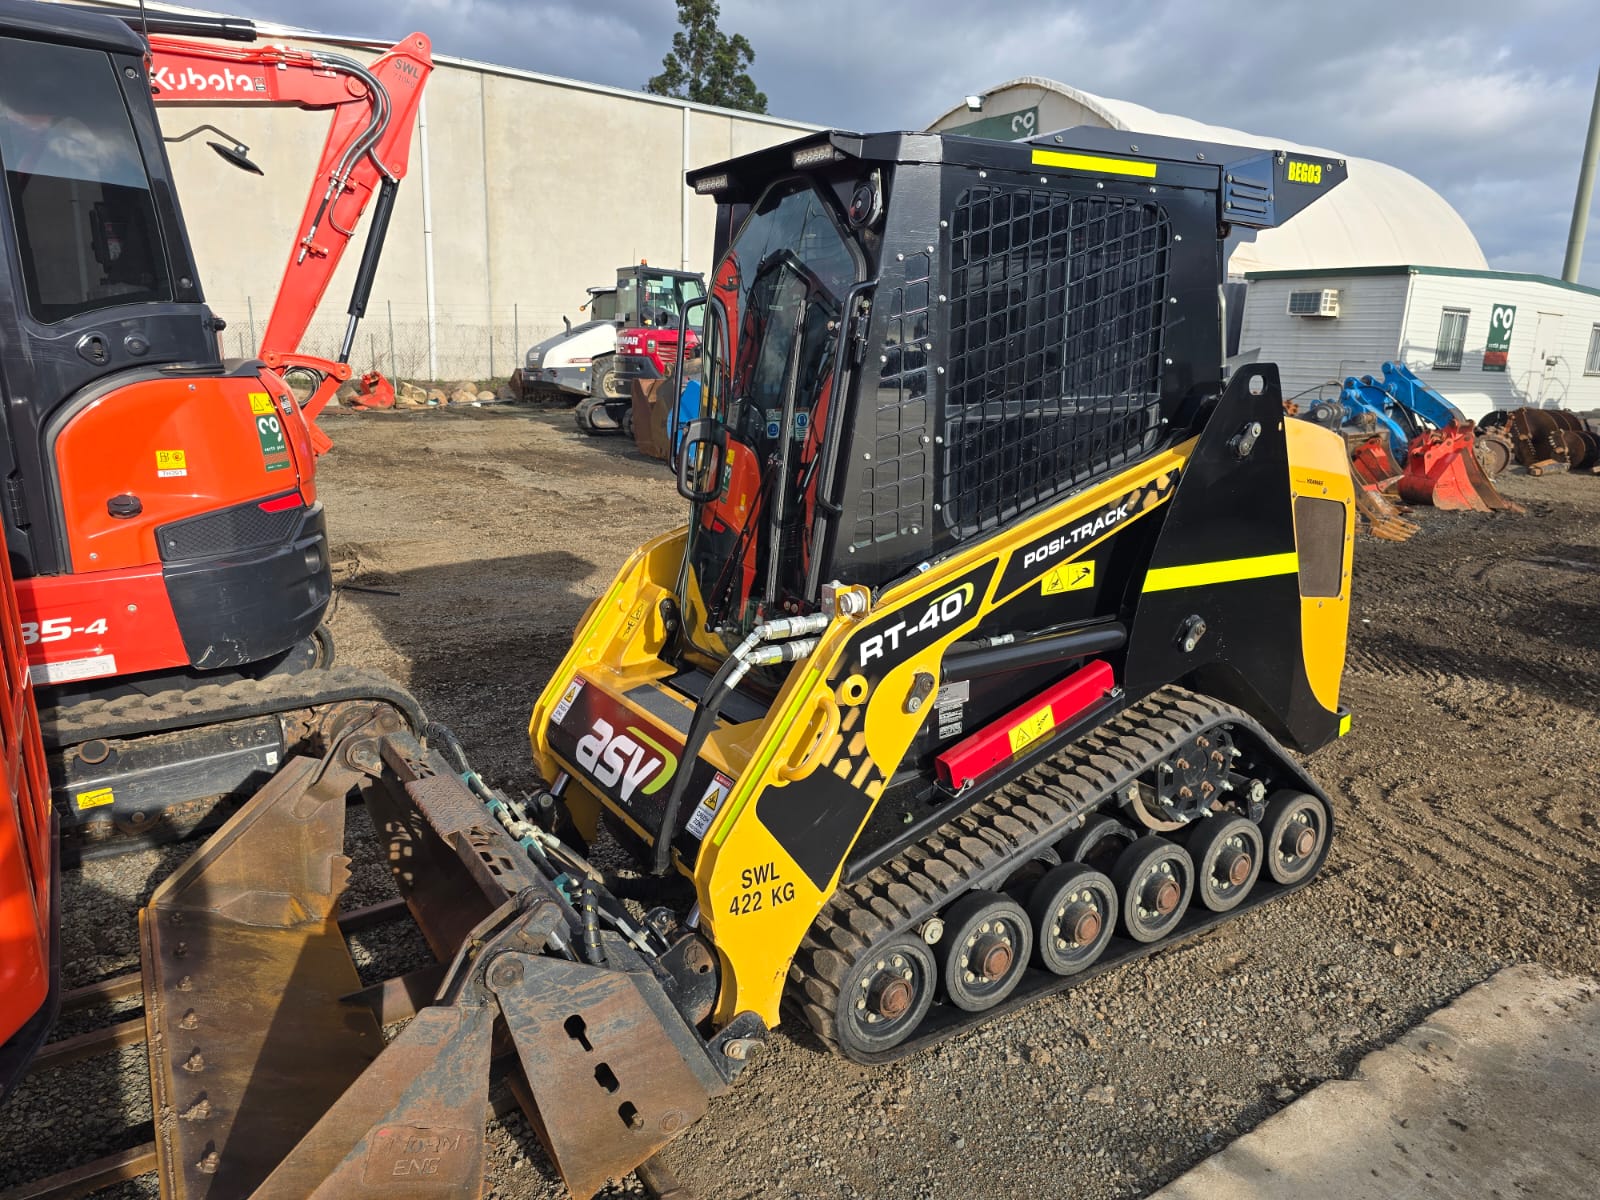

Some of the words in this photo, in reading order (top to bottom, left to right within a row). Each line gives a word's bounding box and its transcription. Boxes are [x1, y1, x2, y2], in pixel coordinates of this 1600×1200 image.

[150, 66, 254, 92] Kubota
[395, 58, 418, 79] SWL
[1023, 505, 1128, 569] POSI-TRACK
[860, 592, 962, 667] RT-40
[741, 862, 780, 889] SWL
[729, 891, 762, 916] 422
[772, 882, 795, 907] KG
